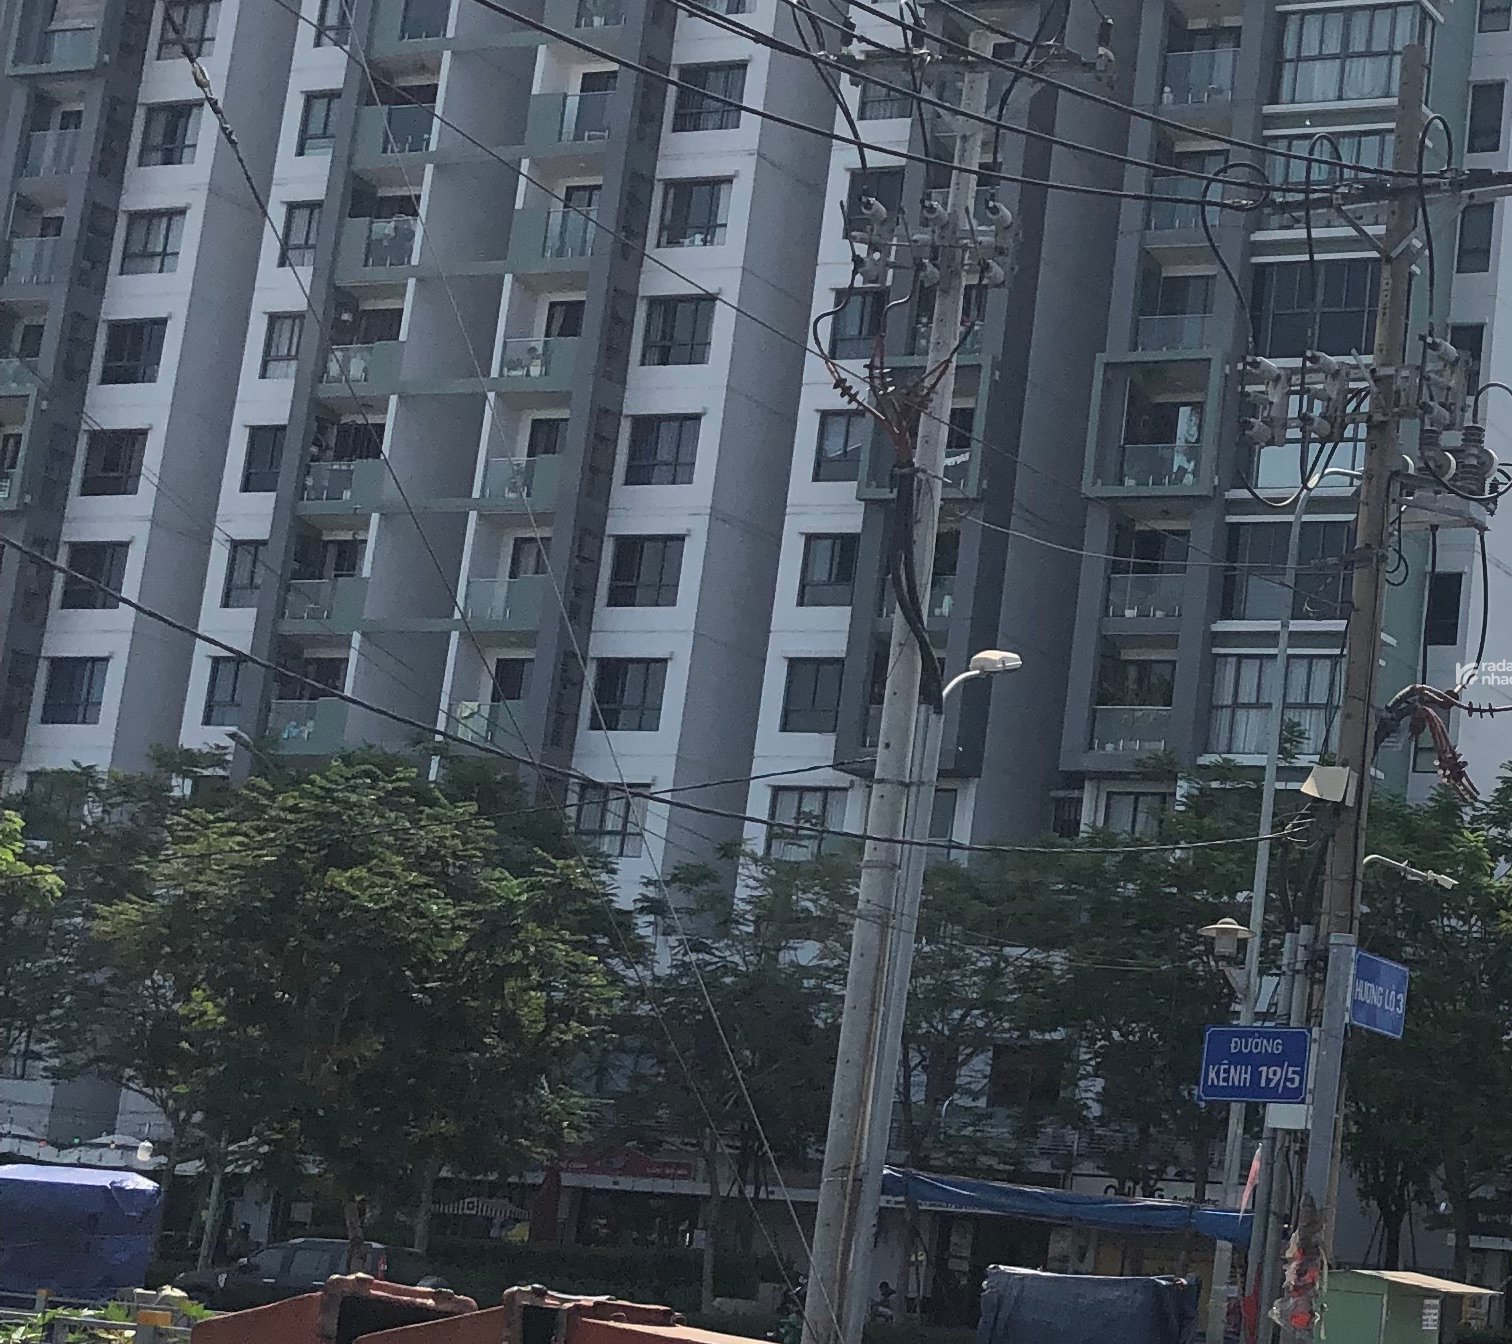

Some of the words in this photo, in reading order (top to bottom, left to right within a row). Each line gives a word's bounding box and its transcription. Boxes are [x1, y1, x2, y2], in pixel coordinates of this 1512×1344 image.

[1397, 993, 1405, 1014] 3
[1230, 1032, 1283, 1054] ĐƯỜNG
[1208, 1060, 1252, 1087] KÊNH
[1258, 1061, 1301, 1093] 19/5
